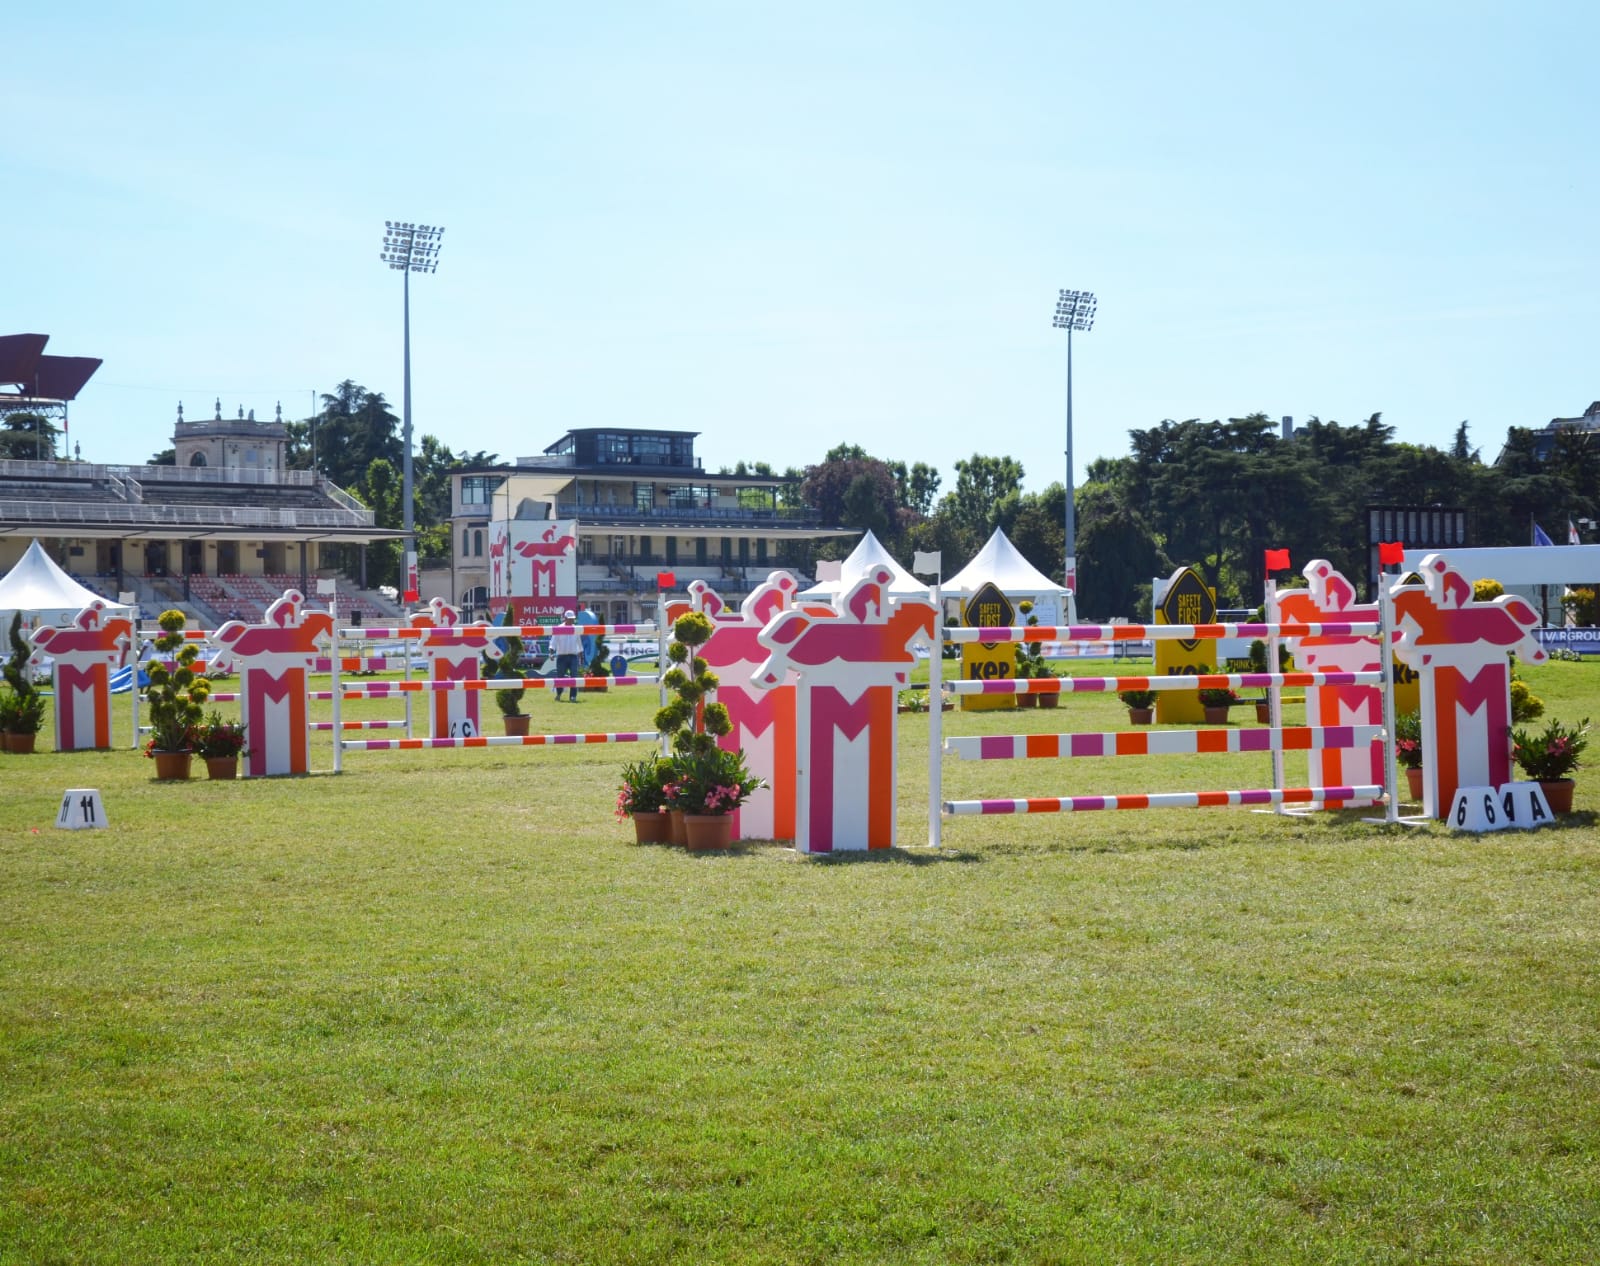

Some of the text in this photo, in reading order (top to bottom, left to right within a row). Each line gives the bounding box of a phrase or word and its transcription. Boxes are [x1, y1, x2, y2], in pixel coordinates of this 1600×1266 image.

[979, 603, 1001, 615] SAFETY
[1178, 593, 1201, 607] SAFETY
[979, 615, 1001, 628] FIRST
[1179, 607, 1201, 625] FIRST
[58, 663, 110, 749] M
[247, 667, 307, 776] M
[462, 722, 471, 738] C
[1434, 663, 1511, 818] M
[808, 685, 893, 852] M
[80, 795, 95, 822] 11
[1457, 795, 1468, 826] 6
[1484, 794, 1496, 825] 6
[1529, 790, 1546, 821] A
